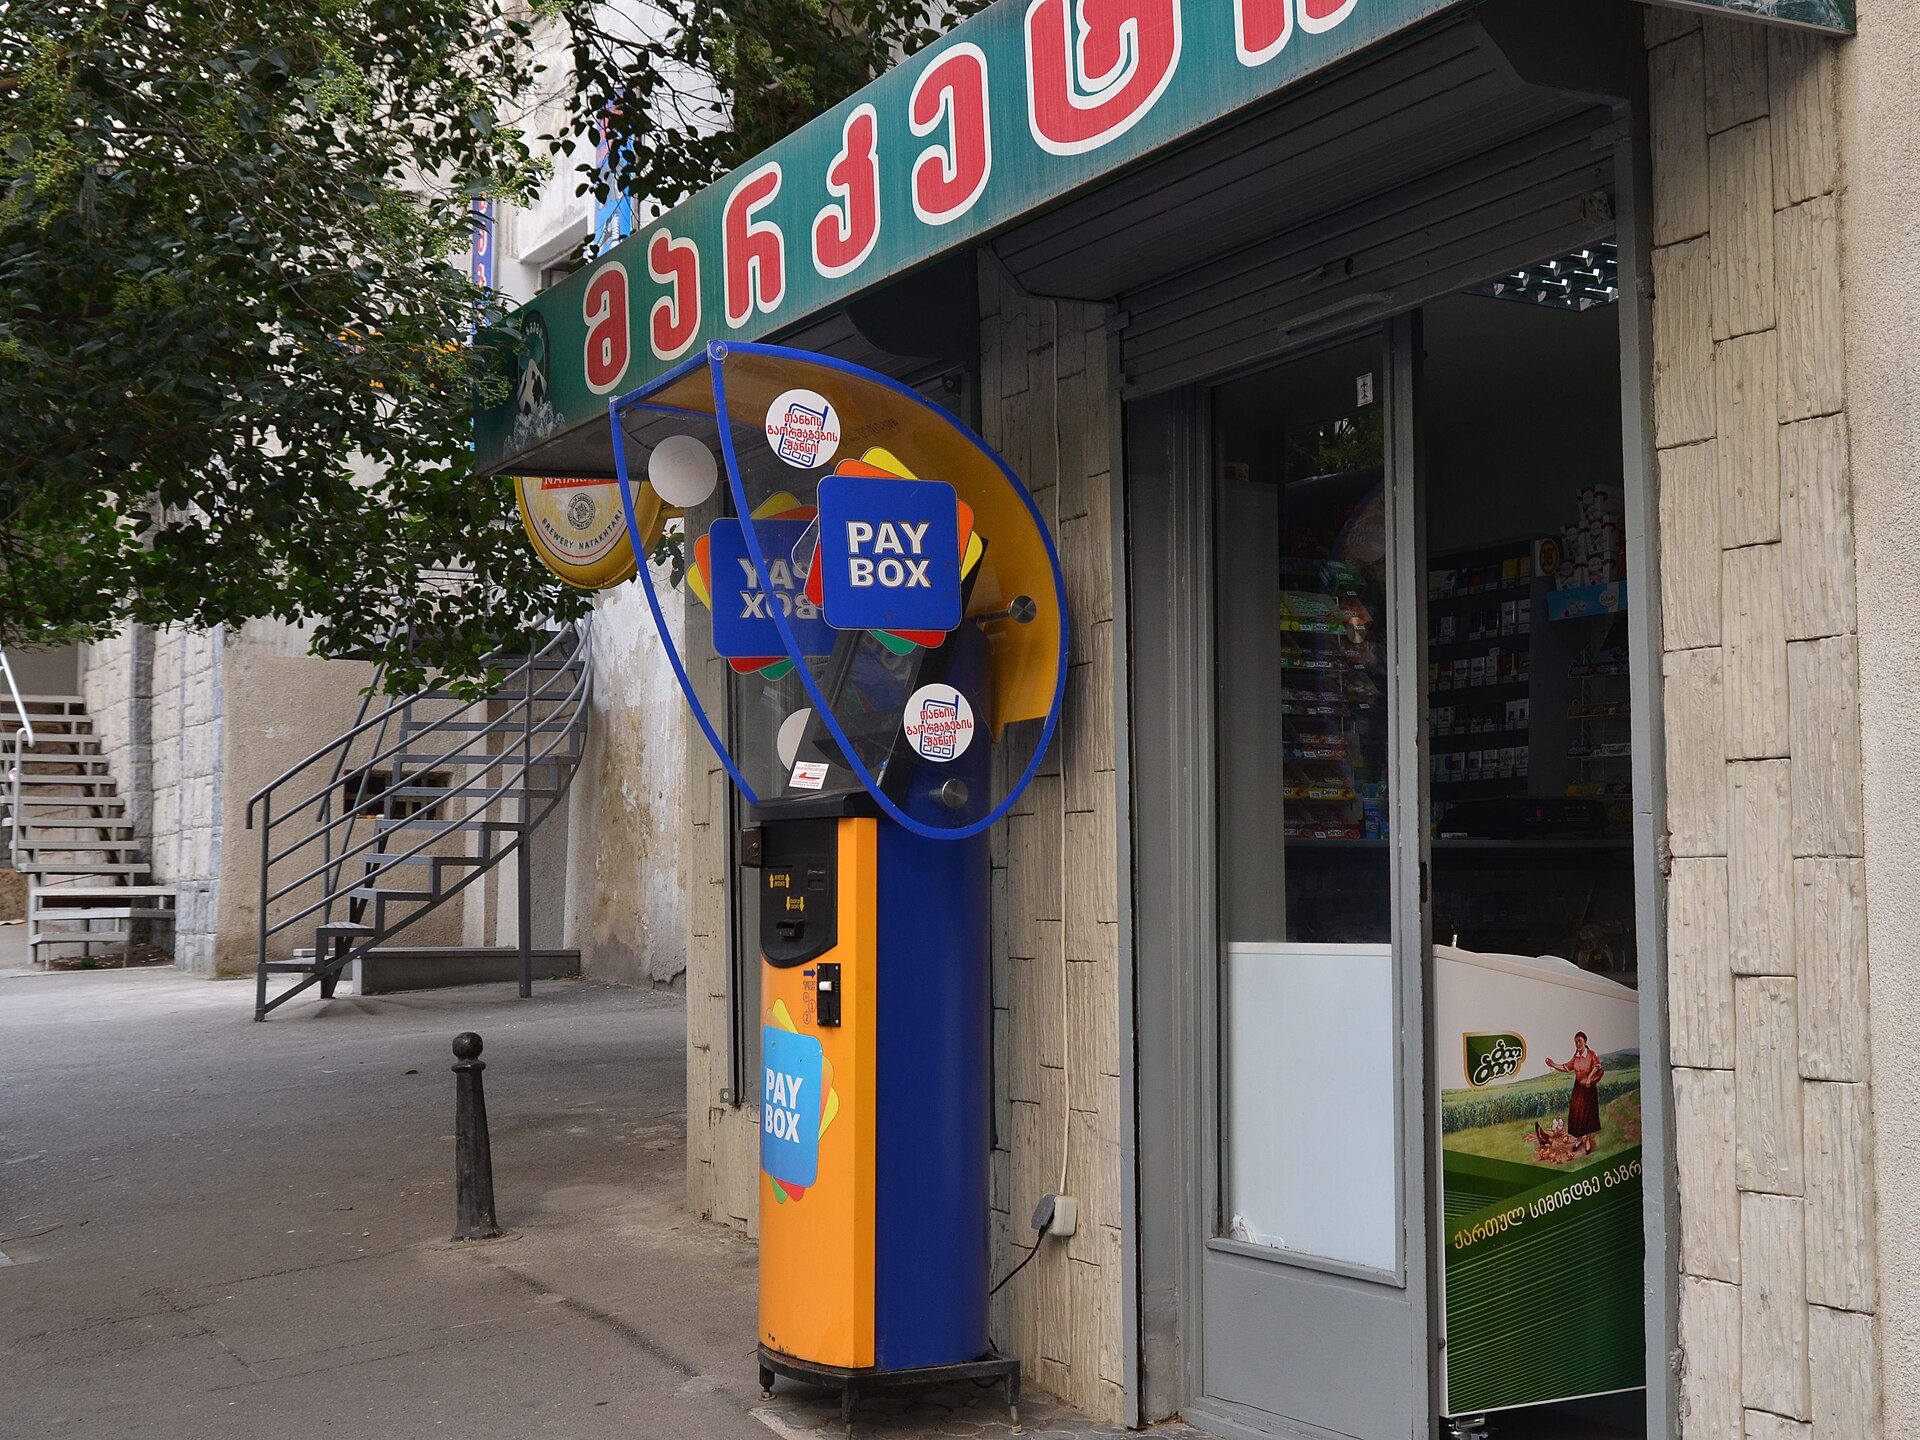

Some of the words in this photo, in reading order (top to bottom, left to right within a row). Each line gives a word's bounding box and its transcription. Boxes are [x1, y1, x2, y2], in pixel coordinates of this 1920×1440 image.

[541, 517, 574, 550] BREWERY
[578, 509, 623, 550] NATAKHTARI
[845, 520, 930, 555] PAY
[848, 557, 932, 589] BOX
[765, 1067, 804, 1111] PAY
[765, 1104, 801, 1144] BOX
[1454, 1206, 1526, 1250] ქართულ
[1529, 1176, 1601, 1219] სიმინდზე
[1604, 1158, 1643, 1188] გაზრ
